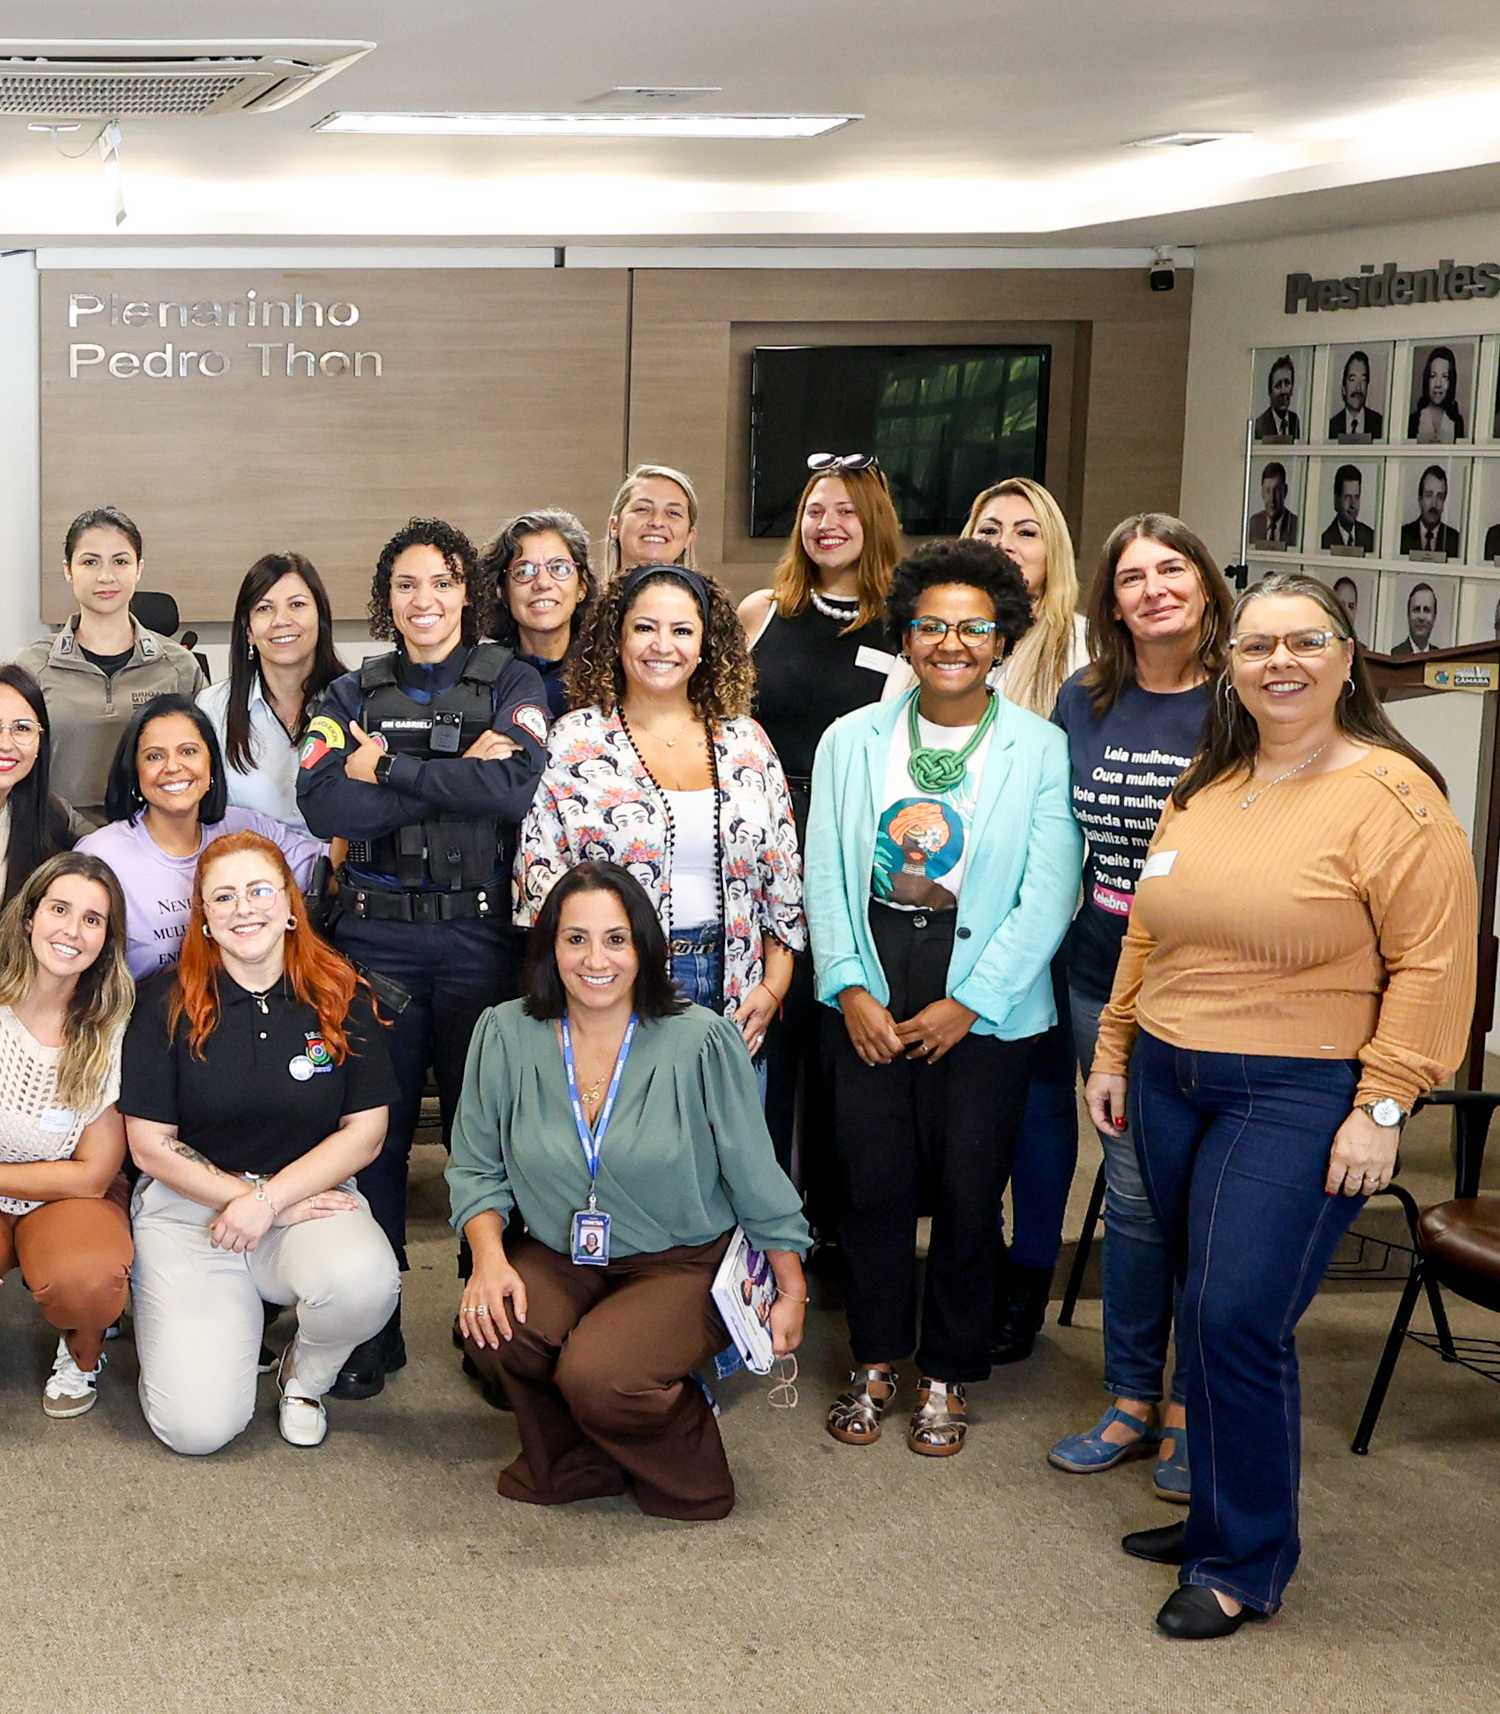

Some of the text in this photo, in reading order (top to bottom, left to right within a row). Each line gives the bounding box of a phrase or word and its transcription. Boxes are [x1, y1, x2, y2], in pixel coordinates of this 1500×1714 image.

[1284, 258, 1500, 314] Presidentes
[68, 290, 360, 328] Plenarinho
[68, 342, 383, 378] Pedro Thon
[1103, 745, 1192, 768] Leia mulheres
[1092, 766, 1124, 785] Ouça
[1073, 785, 1166, 810] Vote em mulhe
